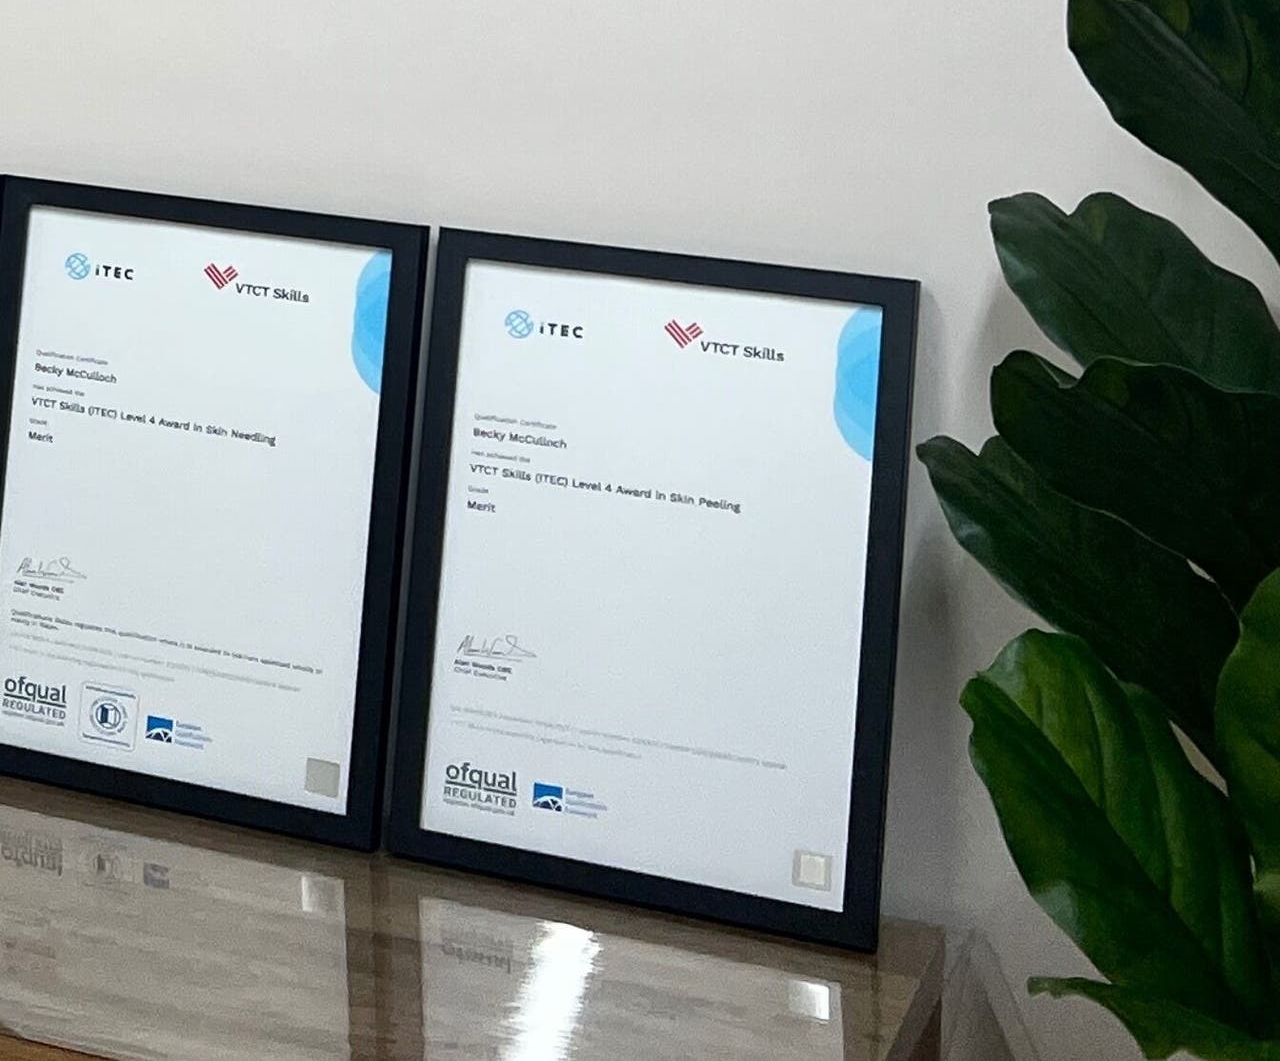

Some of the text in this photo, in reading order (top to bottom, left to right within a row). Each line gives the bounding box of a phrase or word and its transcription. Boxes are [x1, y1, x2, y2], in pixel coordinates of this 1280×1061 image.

[95, 265, 135, 280] iTEC
[235, 283, 310, 303] VTCT Skills
[539, 321, 584, 339] iTEC
[700, 340, 785, 362] VTCT Skills
[35, 362, 118, 384] Becky McCulloch
[31, 397, 57, 409] VTCT
[59, 401, 86, 414] Skills
[120, 411, 147, 424] Level
[149, 415, 156, 424] 4
[158, 418, 190, 431] Award
[192, 422, 203, 433] in
[205, 424, 229, 437] Skin
[28, 430, 54, 444] Merit
[472, 427, 568, 449] Becky McCulloch
[469, 463, 499, 476] VTCT
[501, 467, 532, 482] Skills
[572, 478, 602, 492] Level
[604, 483, 612, 493] 4
[616, 485, 652, 499] Award
[655, 489, 667, 501] in
[669, 492, 695, 505] Skin
[698, 497, 742, 515] Peeling
[466, 499, 497, 513] Merit
[4, 675, 68, 704] ofqual
[1, 698, 67, 720] REGULATED
[445, 761, 517, 792] ofqual
[443, 785, 518, 809] REGULATED
